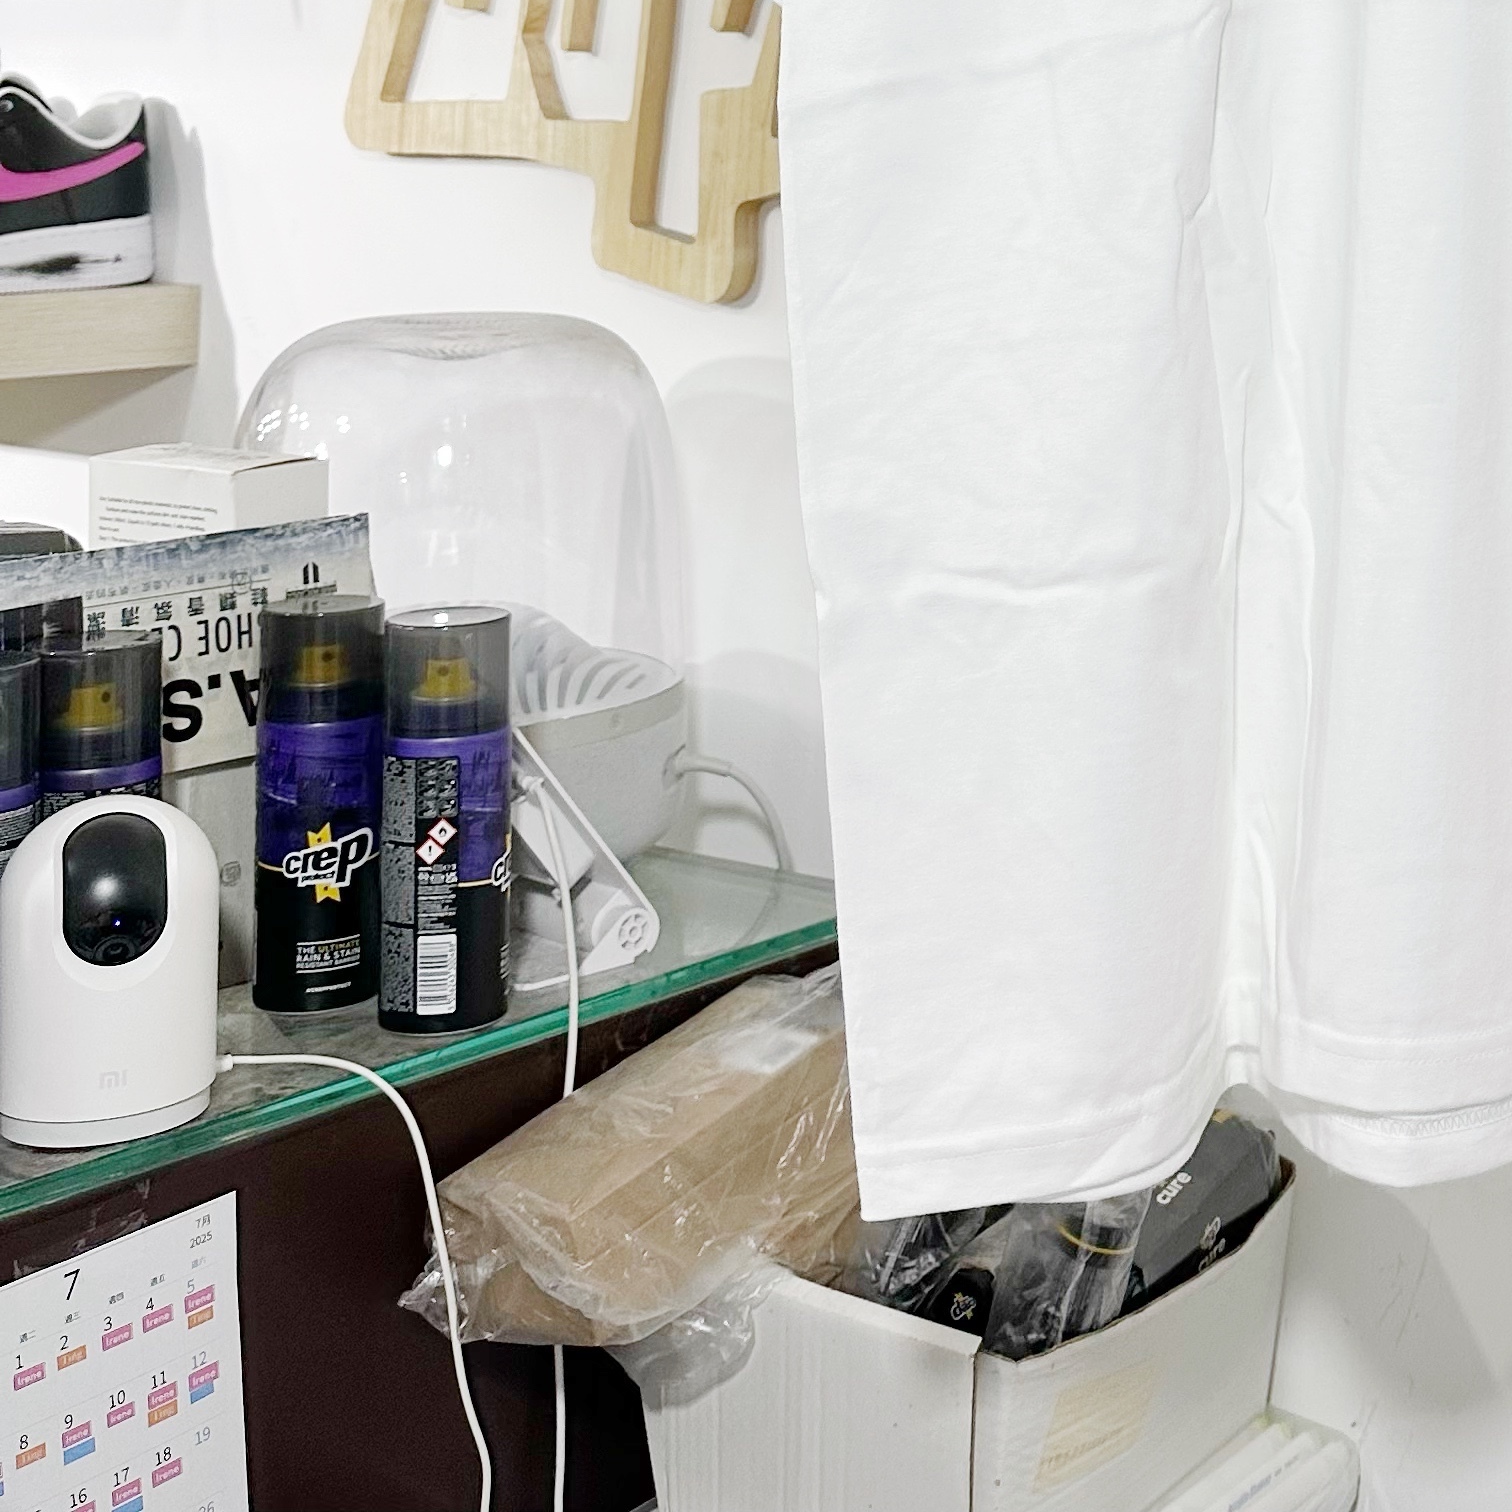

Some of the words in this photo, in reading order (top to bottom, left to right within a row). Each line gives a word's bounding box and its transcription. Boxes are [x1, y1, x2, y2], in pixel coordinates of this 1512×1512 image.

[284, 830, 371, 885] crep
[296, 954, 321, 962] RAIN
[297, 946, 316, 954] THE
[1156, 1172, 1192, 1205] cure
[189, 1231, 213, 1249] 2025
[63, 1268, 81, 1301] 7
[15, 1354, 24, 1370] 1
[60, 1335, 69, 1350] 2
[103, 1316, 113, 1331] 3
[145, 1297, 155, 1311] 4
[187, 1278, 195, 1294] 5
[19, 1434, 29, 1449] 8
[64, 1414, 74, 1430] 9
[109, 1389, 126, 1410] 10
[151, 1370, 167, 1390] 11
[191, 1351, 207, 1370] 12
[69, 1487, 88, 1509] 16
[113, 1466, 130, 1488] 17
[155, 1446, 172, 1467] 18
[195, 1426, 211, 1446] 19
